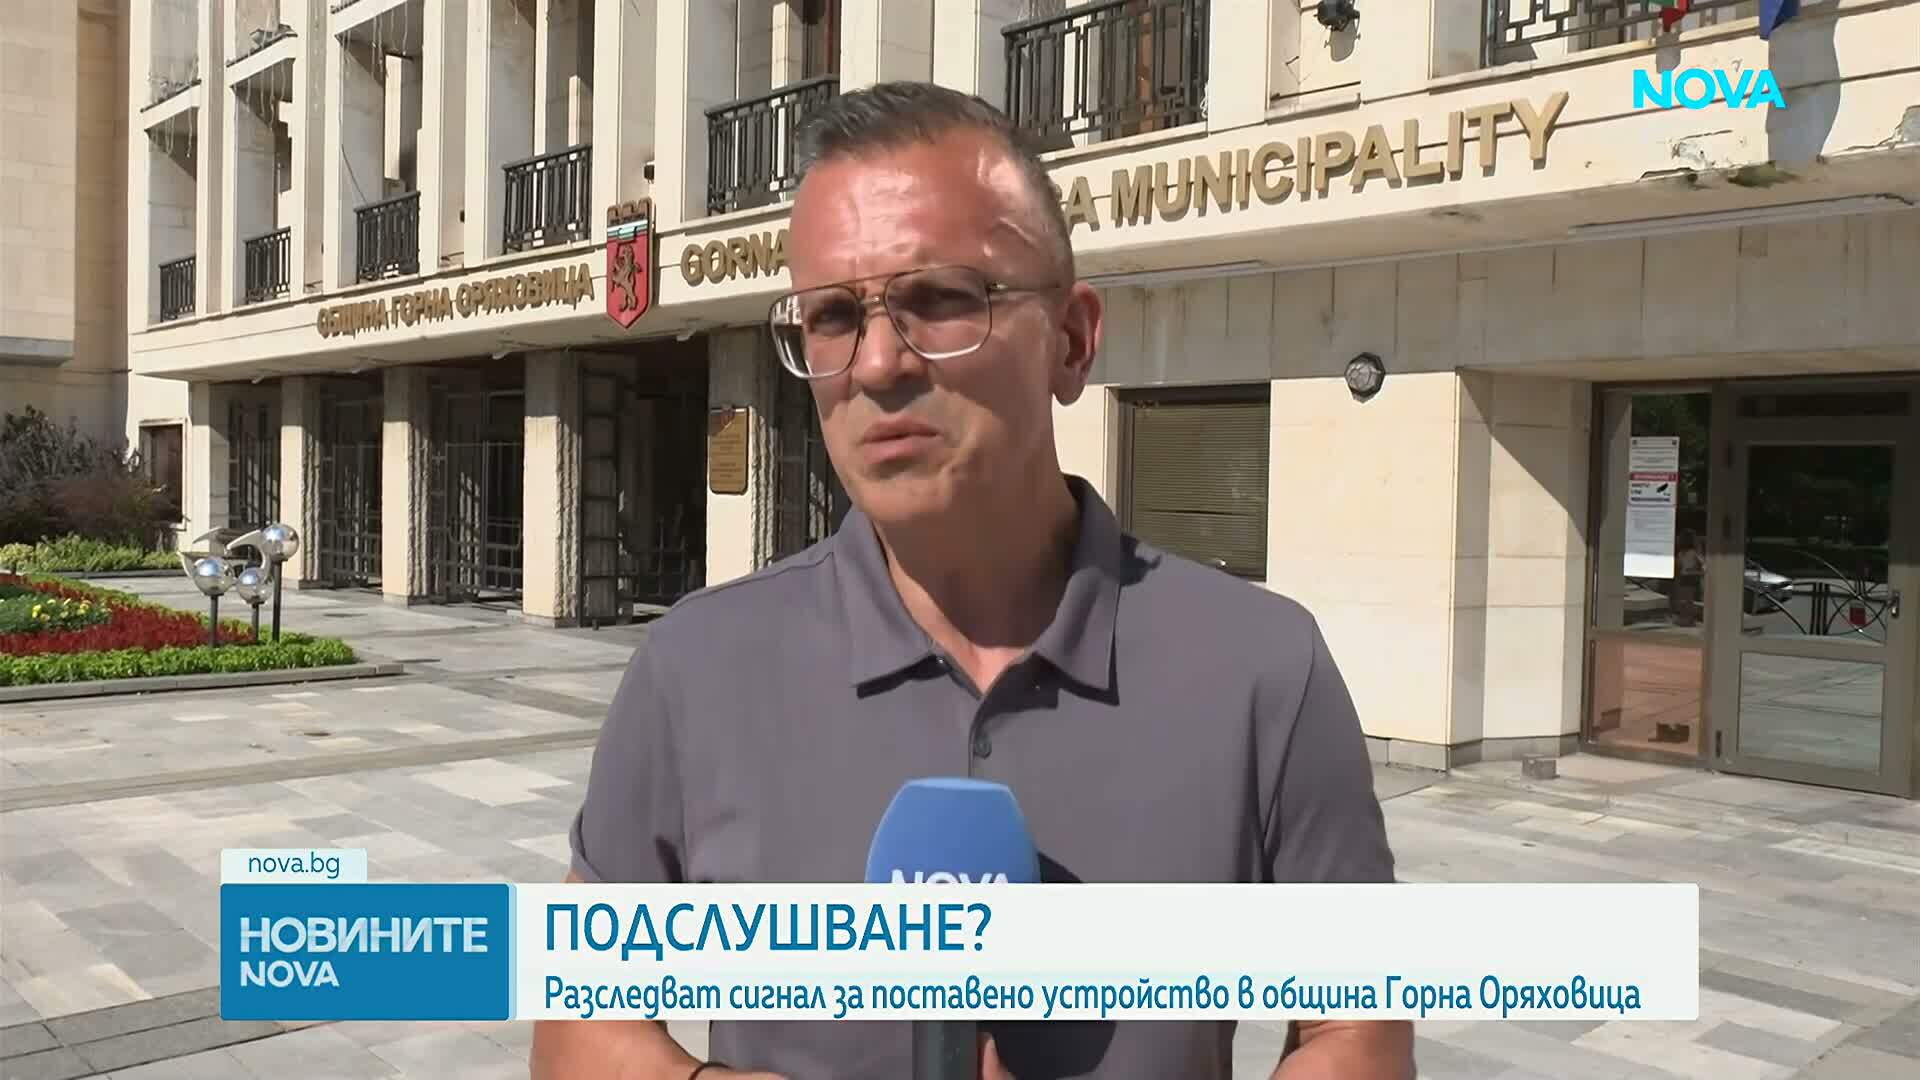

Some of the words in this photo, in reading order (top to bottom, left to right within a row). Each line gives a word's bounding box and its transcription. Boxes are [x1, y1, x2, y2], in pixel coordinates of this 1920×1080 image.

[680, 228, 791, 287] GORNA
[1111, 91, 1569, 229] MUNICIPALITY
[317, 298, 389, 339] ОБЩИНА
[391, 287, 454, 327] ГОРНА
[456, 262, 595, 319] ОРЯХОВИЦА
